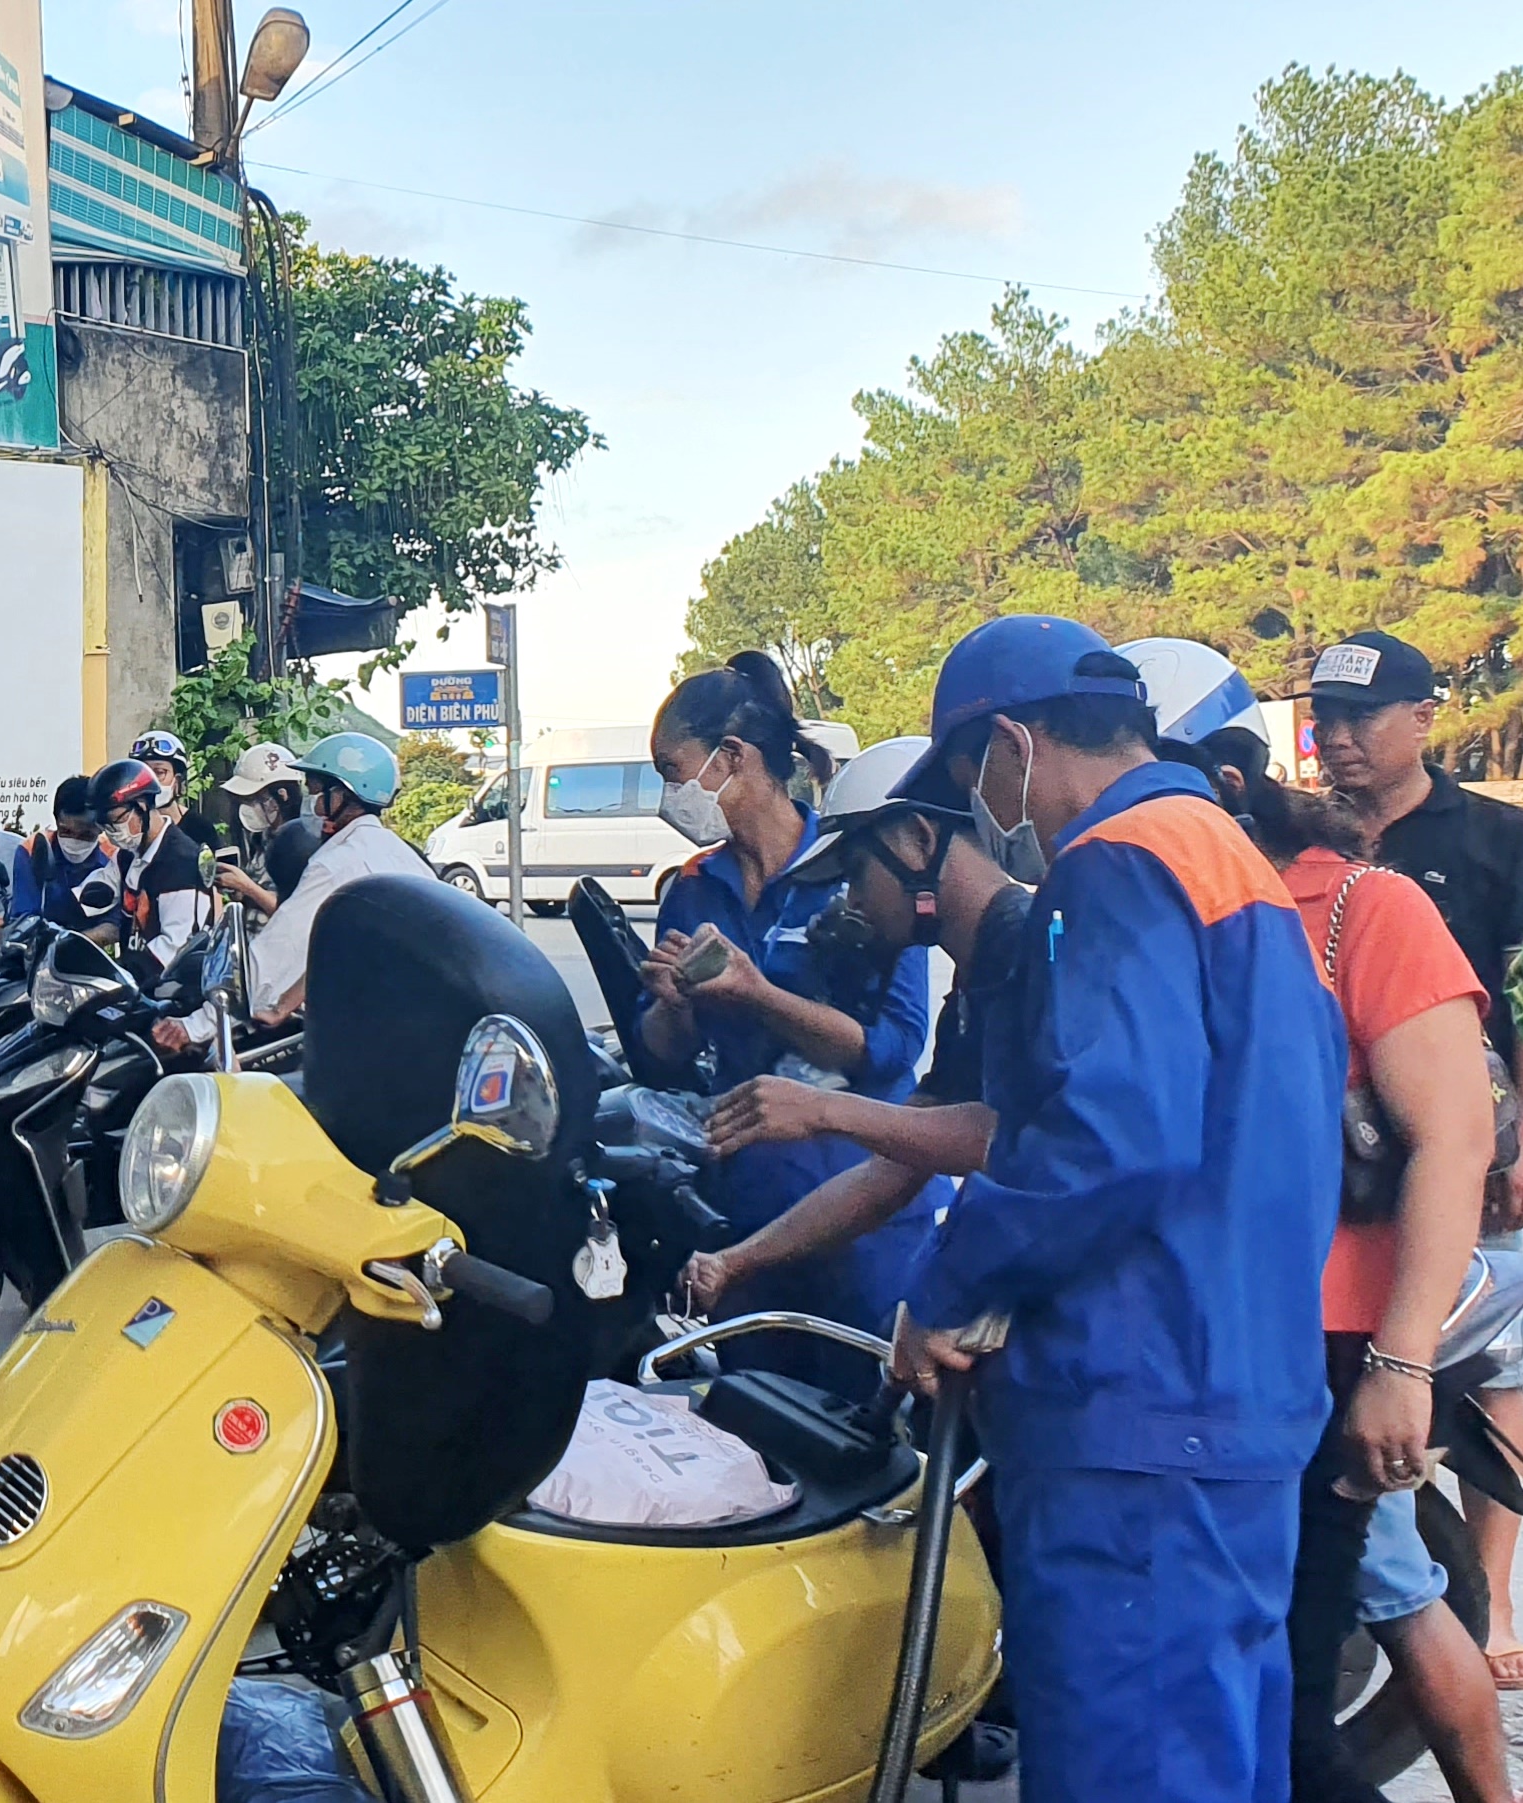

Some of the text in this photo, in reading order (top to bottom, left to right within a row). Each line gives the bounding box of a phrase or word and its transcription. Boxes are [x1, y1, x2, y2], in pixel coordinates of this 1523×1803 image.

[430, 675, 473, 687] ĐƯỜNG
[439, 701, 471, 722] BIÊN
[473, 698, 500, 720] PHỦ
[8, 777, 27, 789] siêu
[32, 793, 49, 805] học
